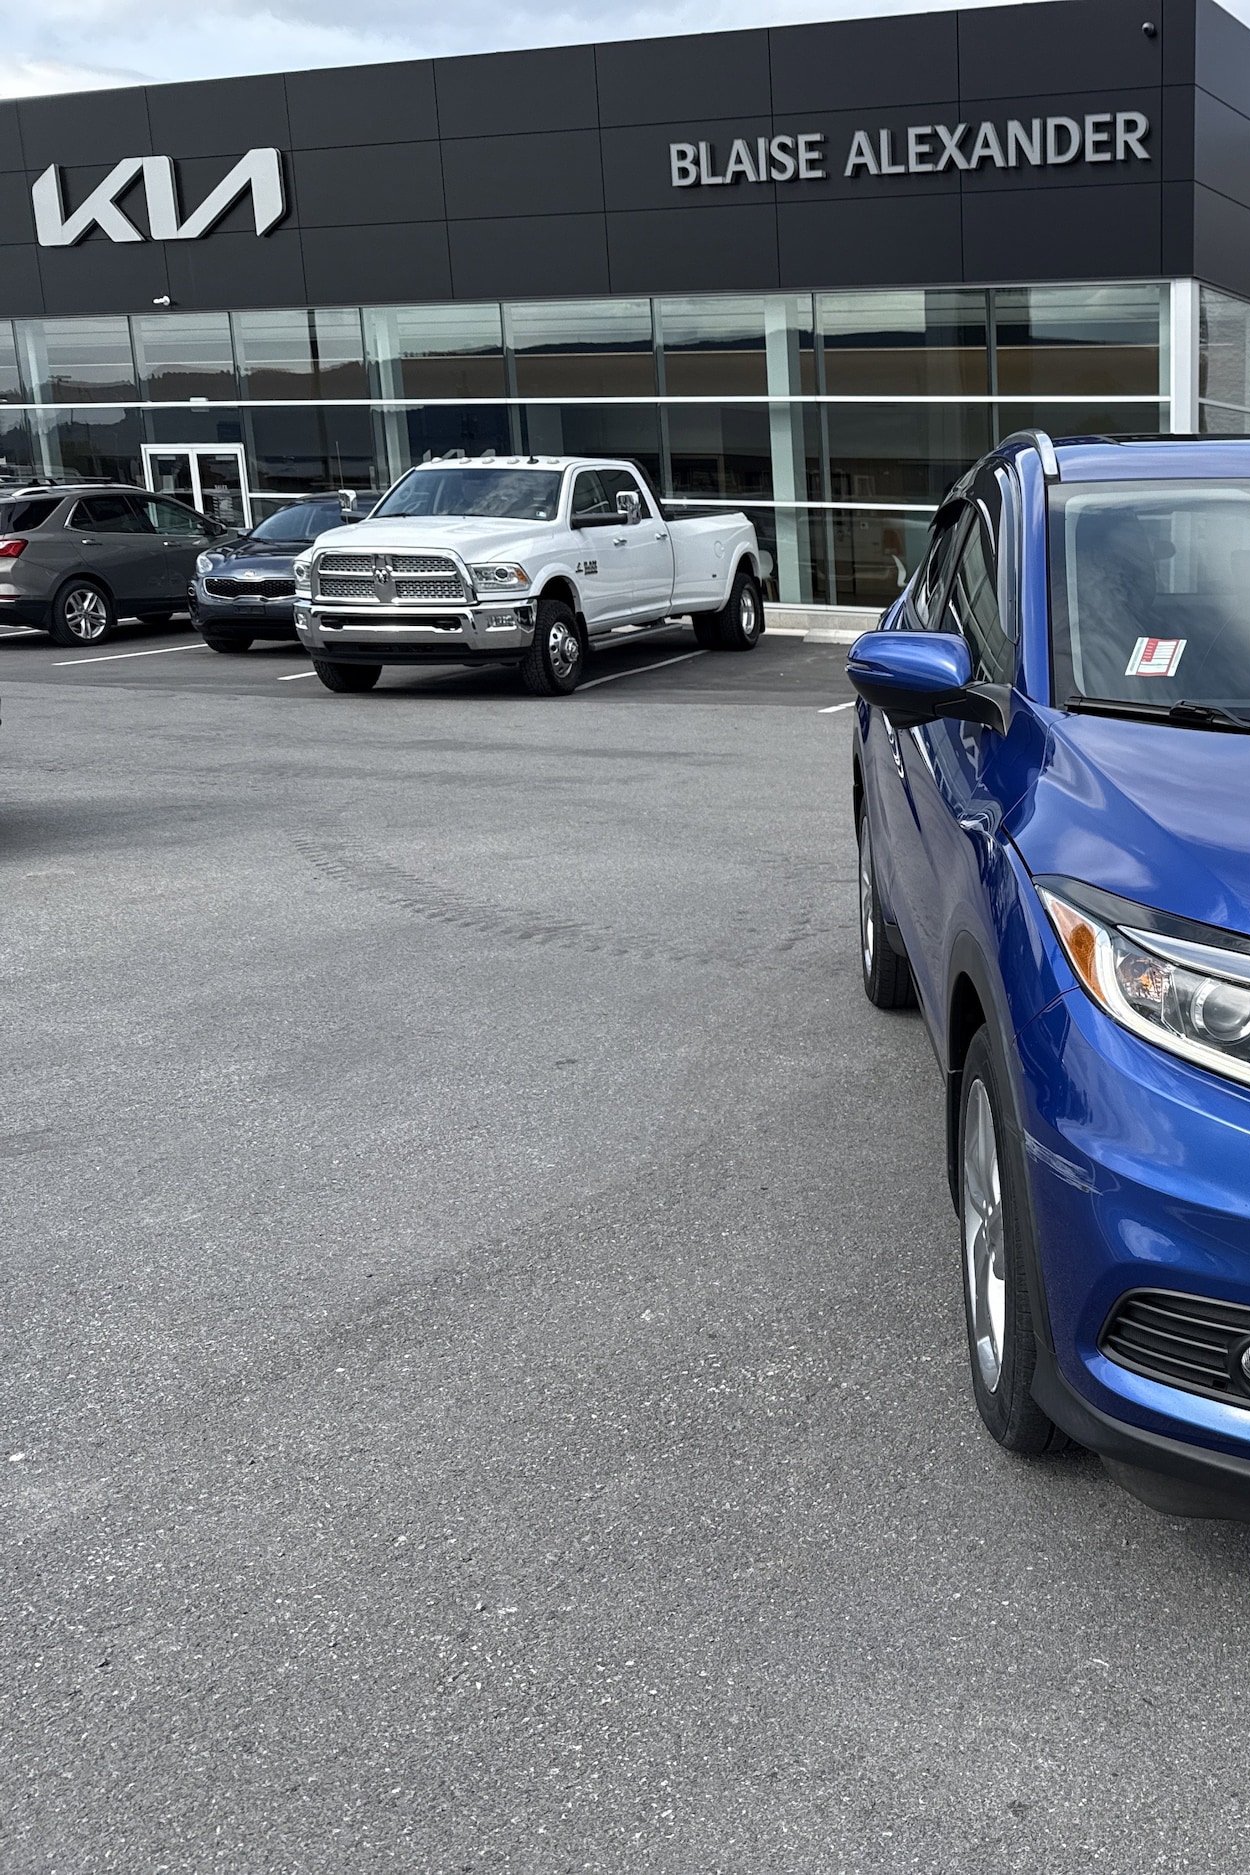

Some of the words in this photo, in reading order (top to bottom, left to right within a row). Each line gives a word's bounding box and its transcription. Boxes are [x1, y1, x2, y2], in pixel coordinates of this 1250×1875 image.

[669, 133, 827, 187] BLAISE
[844, 111, 1151, 176] ALEXANDER
[32, 147, 286, 247] KIA
